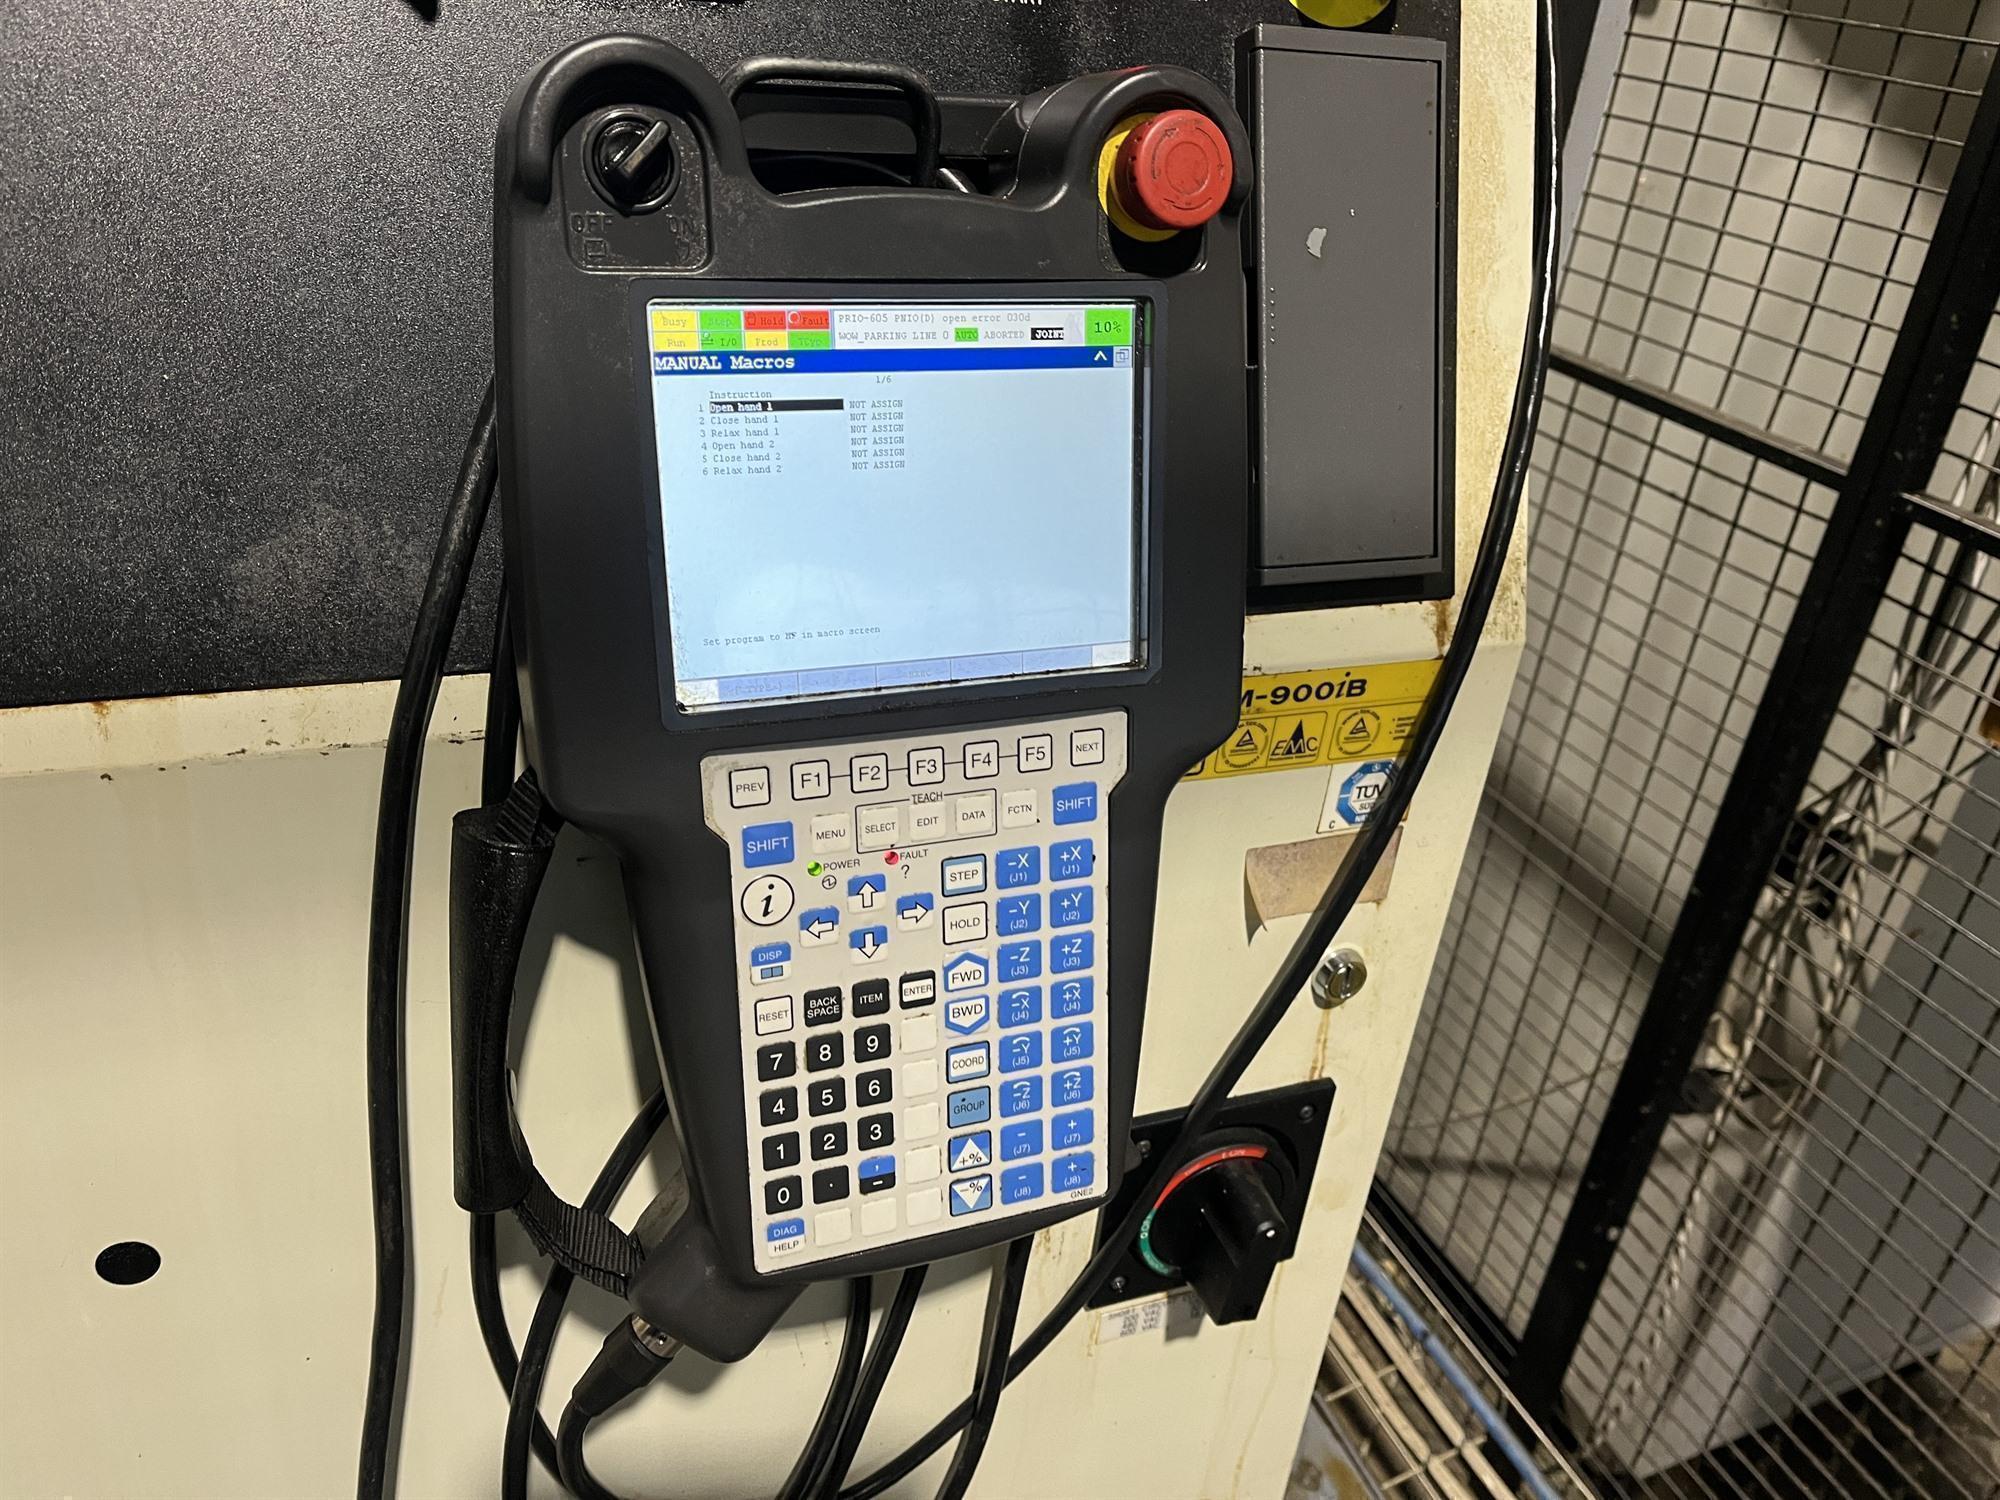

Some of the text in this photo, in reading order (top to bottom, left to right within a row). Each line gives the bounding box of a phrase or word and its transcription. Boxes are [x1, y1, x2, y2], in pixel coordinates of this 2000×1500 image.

[570, 212, 613, 233] OFF
[761, 316, 784, 326] Hold
[802, 316, 829, 326] Fault
[838, 313, 888, 323] PRIO-605
[942, 315, 967, 324] open
[972, 314, 1001, 322] error
[1007, 313, 1031, 322] 030d
[1095, 321, 1122, 334] 10%
[720, 338, 737, 347] I/O
[838, 331, 907, 344] WOW_PARKING
[913, 331, 937, 340] LINE
[956, 330, 978, 340] AUTO
[984, 331, 1025, 340] ABORTED
[668, 339, 686, 348] Run
[655, 355, 795, 371] MANUAL Macros
[876, 375, 892, 384] 1/6
[709, 391, 772, 399] Instruction
[710, 403, 734, 413] Open
[738, 402, 762, 412] hand
[849, 400, 903, 409] NOT ASSIGN
[711, 416, 739, 425] Close
[745, 416, 768, 424] hand
[850, 412, 904, 421] NOT ASSIGN
[711, 429, 740, 438] Relax
[745, 428, 769, 437] hand
[850, 424, 904, 434] NOT ASSIGN
[712, 442, 736, 452] Open
[740, 441, 764, 450] hand
[851, 436, 905, 446] NOT ASSIGN
[713, 454, 742, 463] Close
[747, 453, 770, 462] hand
[851, 448, 905, 458] NOT ASSIGN
[714, 467, 742, 476] Relax
[748, 466, 771, 474] hand
[852, 460, 905, 470] NOT ASSIGN
[703, 638, 720, 647] Set
[725, 635, 765, 648] program
[817, 629, 844, 638] macro
[849, 626, 881, 635] screen
[1075, 742, 1099, 752] NEXT
[1271, 737, 1318, 756] EMC
[971, 752, 992, 768] F4
[1026, 746, 1046, 762] F5
[916, 759, 937, 775] F3
[860, 765, 881, 782] F2
[801, 772, 822, 789] F1
[735, 782, 765, 793] PREV
[911, 791, 943, 804] TEACH
[1008, 804, 1032, 815] FCTN
[1056, 797, 1092, 812] SHIFT
[917, 816, 938, 827] EDIT
[962, 811, 986, 821] DATA
[865, 822, 896, 834] SELECT
[816, 829, 846, 841] MENU
[746, 837, 789, 854] SHIFT
[900, 849, 929, 860] FAULT
[1060, 845, 1082, 862] +X
[823, 859, 860, 871] POWER
[1008, 853, 1029, 868] -X
[949, 869, 979, 882] STEP
[1062, 865, 1080, 876] (J1)
[1009, 872, 1027, 883] (J1)
[1061, 892, 1082, 908] +Y
[1009, 900, 1030, 915] -Y
[1062, 911, 1080, 922] (J2)
[950, 917, 981, 931] HOLD
[1010, 919, 1028, 930] (J2)
[1061, 938, 1082, 955] +Z
[758, 951, 782, 962] DISP
[1010, 947, 1030, 962] -Z
[1063, 957, 1080, 968] (J3)
[952, 969, 982, 984] FWD
[1011, 965, 1028, 976] (J3)
[903, 985, 932, 996] ENTER
[810, 996, 837, 1008] BACK
[860, 993, 883, 1004] ITEM
[806, 1006, 840, 1018] SPACE
[952, 1003, 983, 1018] BWD
[1063, 1002, 1080, 1014] (J4)
[758, 1013, 789, 1023] RESET
[1012, 1011, 1029, 1023] (J4)
[866, 1035, 879, 1052] 9
[819, 1044, 832, 1062] 8
[1064, 1046, 1081, 1058] (J5)
[770, 1053, 782, 1071] 7
[952, 1056, 984, 1070] COORD
[1013, 1055, 1030, 1066] (J5)
[868, 1079, 881, 1097] 6
[821, 1088, 834, 1106] 5
[1064, 1090, 1081, 1101] (J6)
[772, 1098, 786, 1116] 4
[953, 1101, 985, 1115] GROUP
[1013, 1101, 1030, 1112] (J6)
[870, 1124, 882, 1141] 3
[823, 1133, 836, 1151] 2
[1064, 1134, 1081, 1145] (J7)
[776, 1143, 785, 1160] 1
[1013, 1144, 1030, 1155] (J7)
[777, 1187, 790, 1204] 0
[1014, 1187, 1031, 1198] (J8)
[773, 1225, 797, 1237] DIAG
[774, 1240, 799, 1252] HELP
